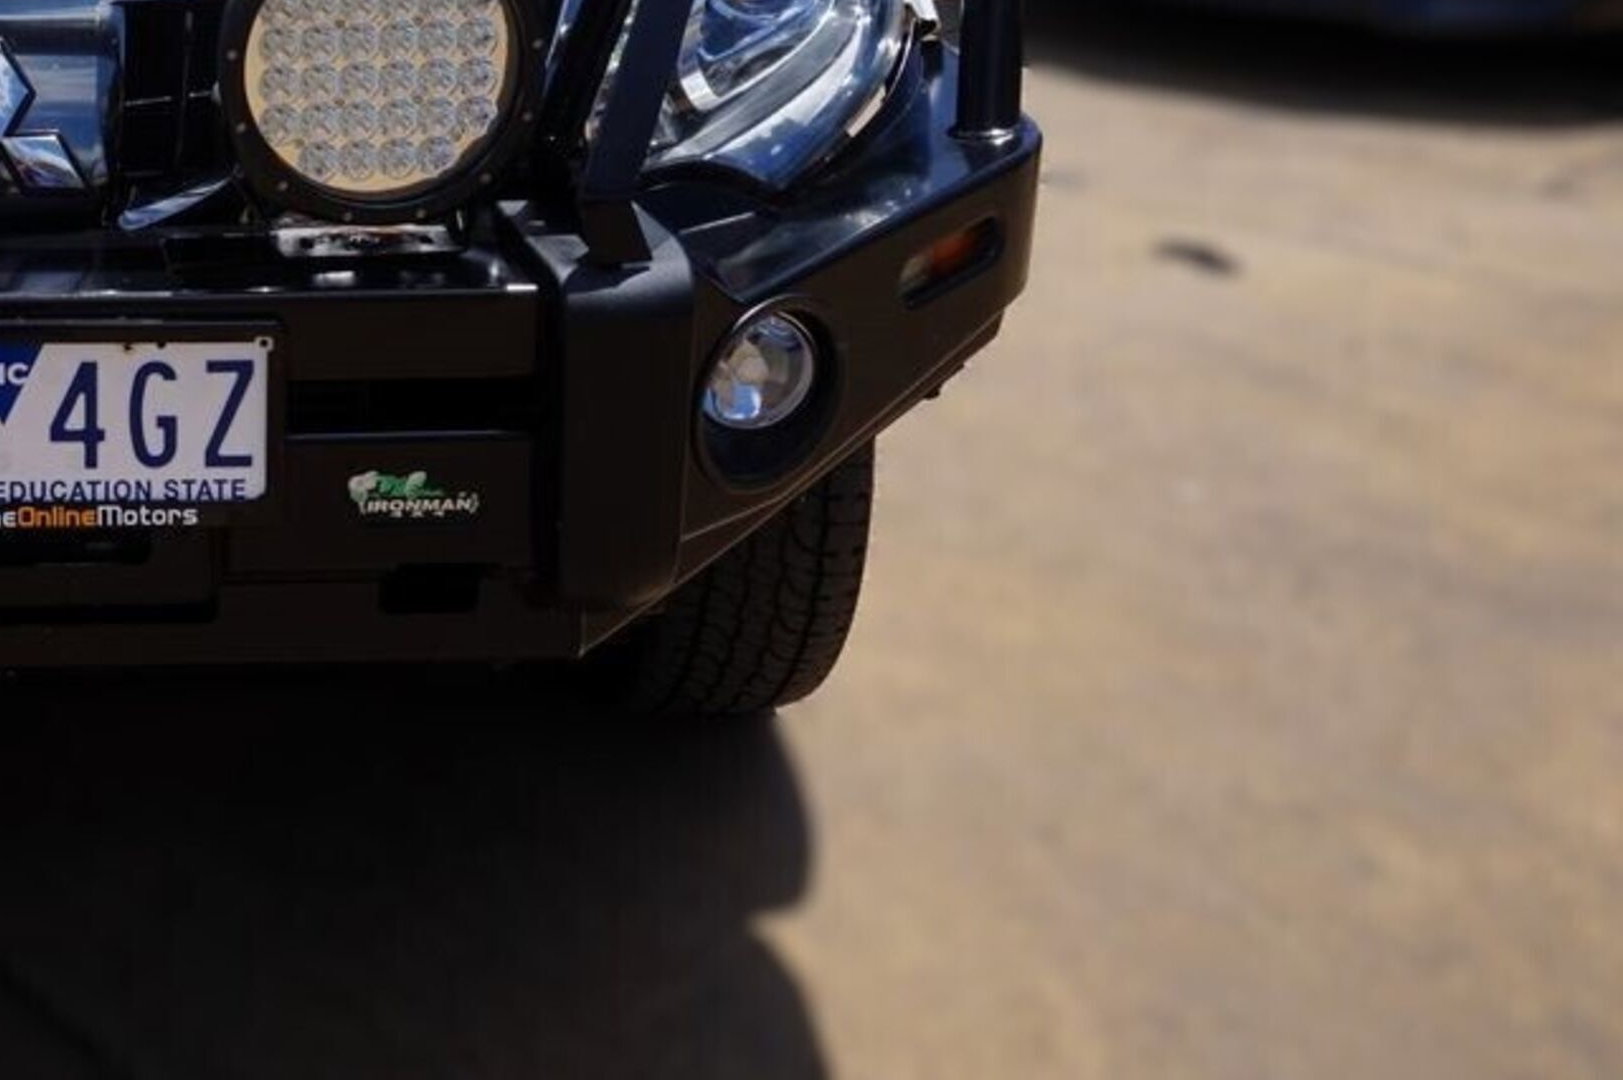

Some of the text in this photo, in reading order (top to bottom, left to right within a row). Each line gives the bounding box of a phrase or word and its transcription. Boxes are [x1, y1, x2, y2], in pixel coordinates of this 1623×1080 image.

[49, 359, 255, 470] 4GZ
[163, 478, 247, 501] STATE
[367, 497, 472, 513] IRONMAN
